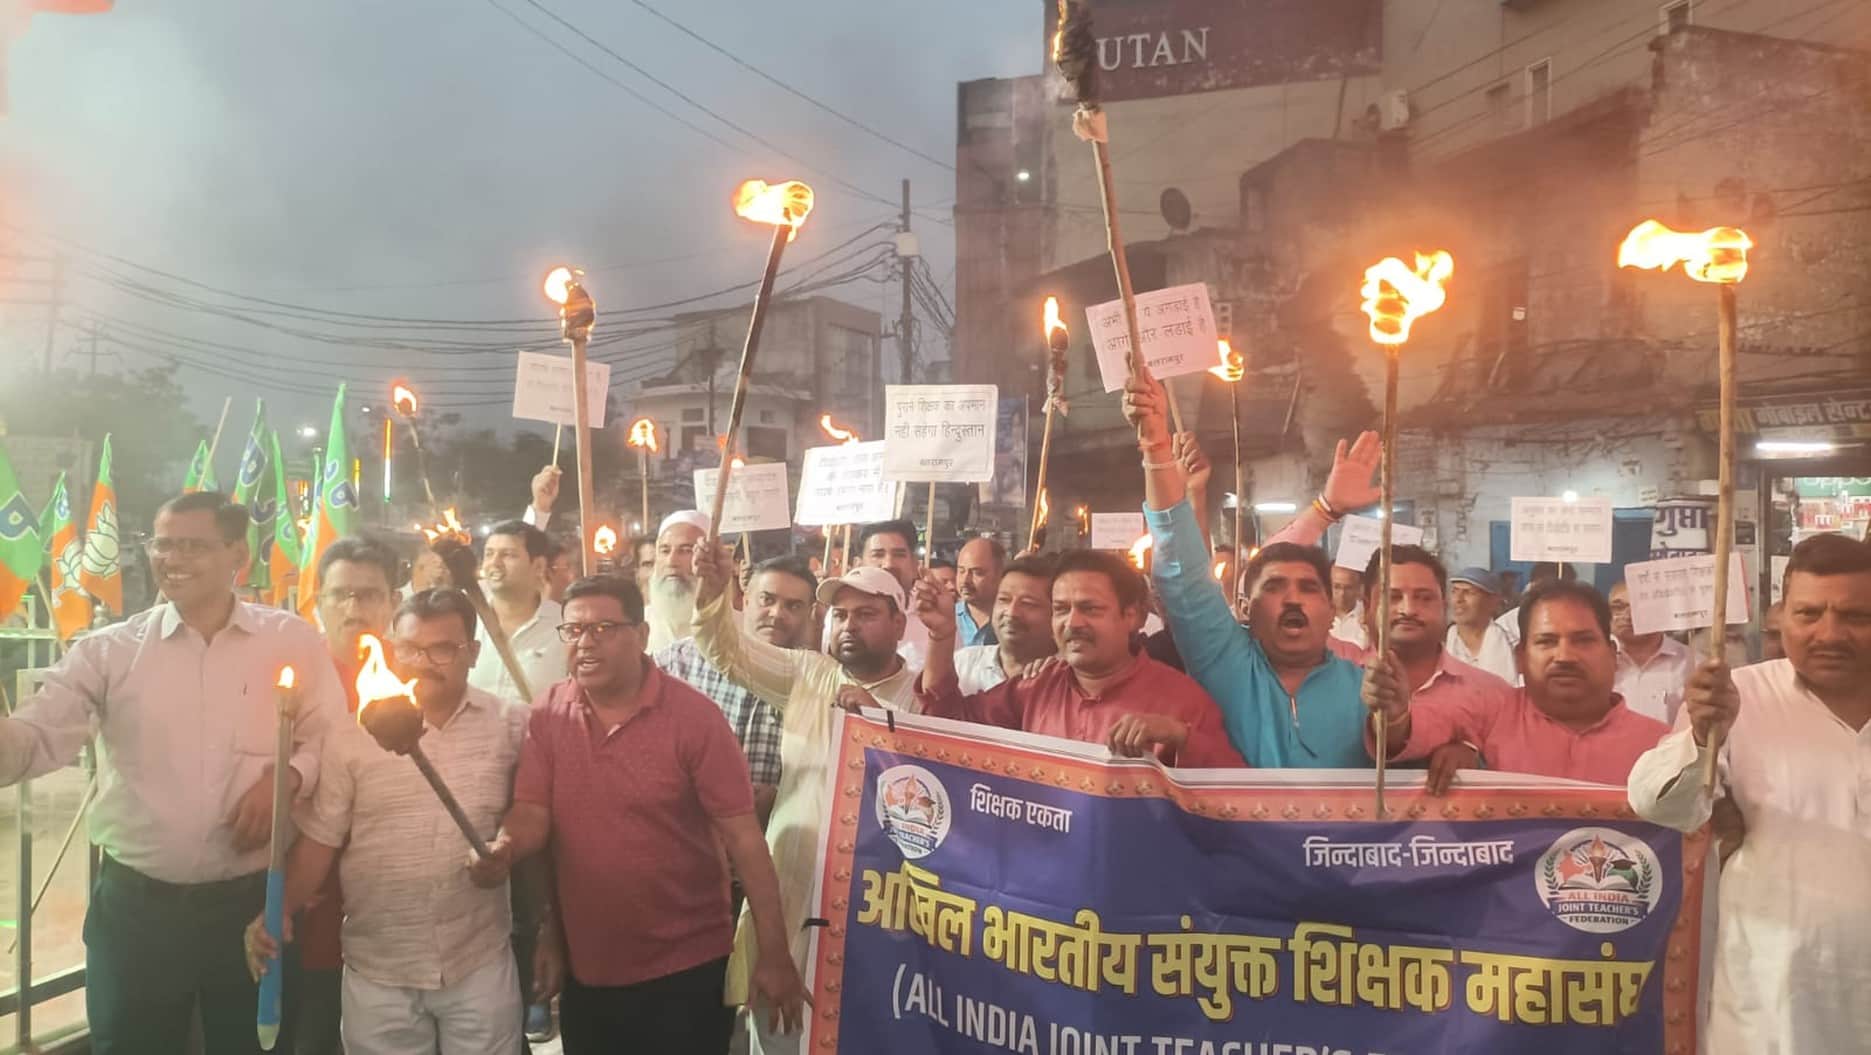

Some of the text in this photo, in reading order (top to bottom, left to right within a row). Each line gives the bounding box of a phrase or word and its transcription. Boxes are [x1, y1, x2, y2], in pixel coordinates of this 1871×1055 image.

[1096, 27, 1211, 71] UTAN
[969, 783, 1073, 833] शिक्षक एकता
[1302, 835, 1515, 867] जिन्दाबाद-जिन्दाबाद
[1558, 903, 1639, 916] JOINT TEACHER'S
[1568, 891, 1630, 903] ALL INDIA
[1569, 915, 1630, 925] FEDERATION
[982, 907, 1143, 996] भारतीय
[1147, 914, 1283, 1022] संयुक्त
[1288, 922, 1455, 1012] शिक्षक
[892, 962, 949, 1029] (ALL
[957, 996, 1038, 1055] INDIA
